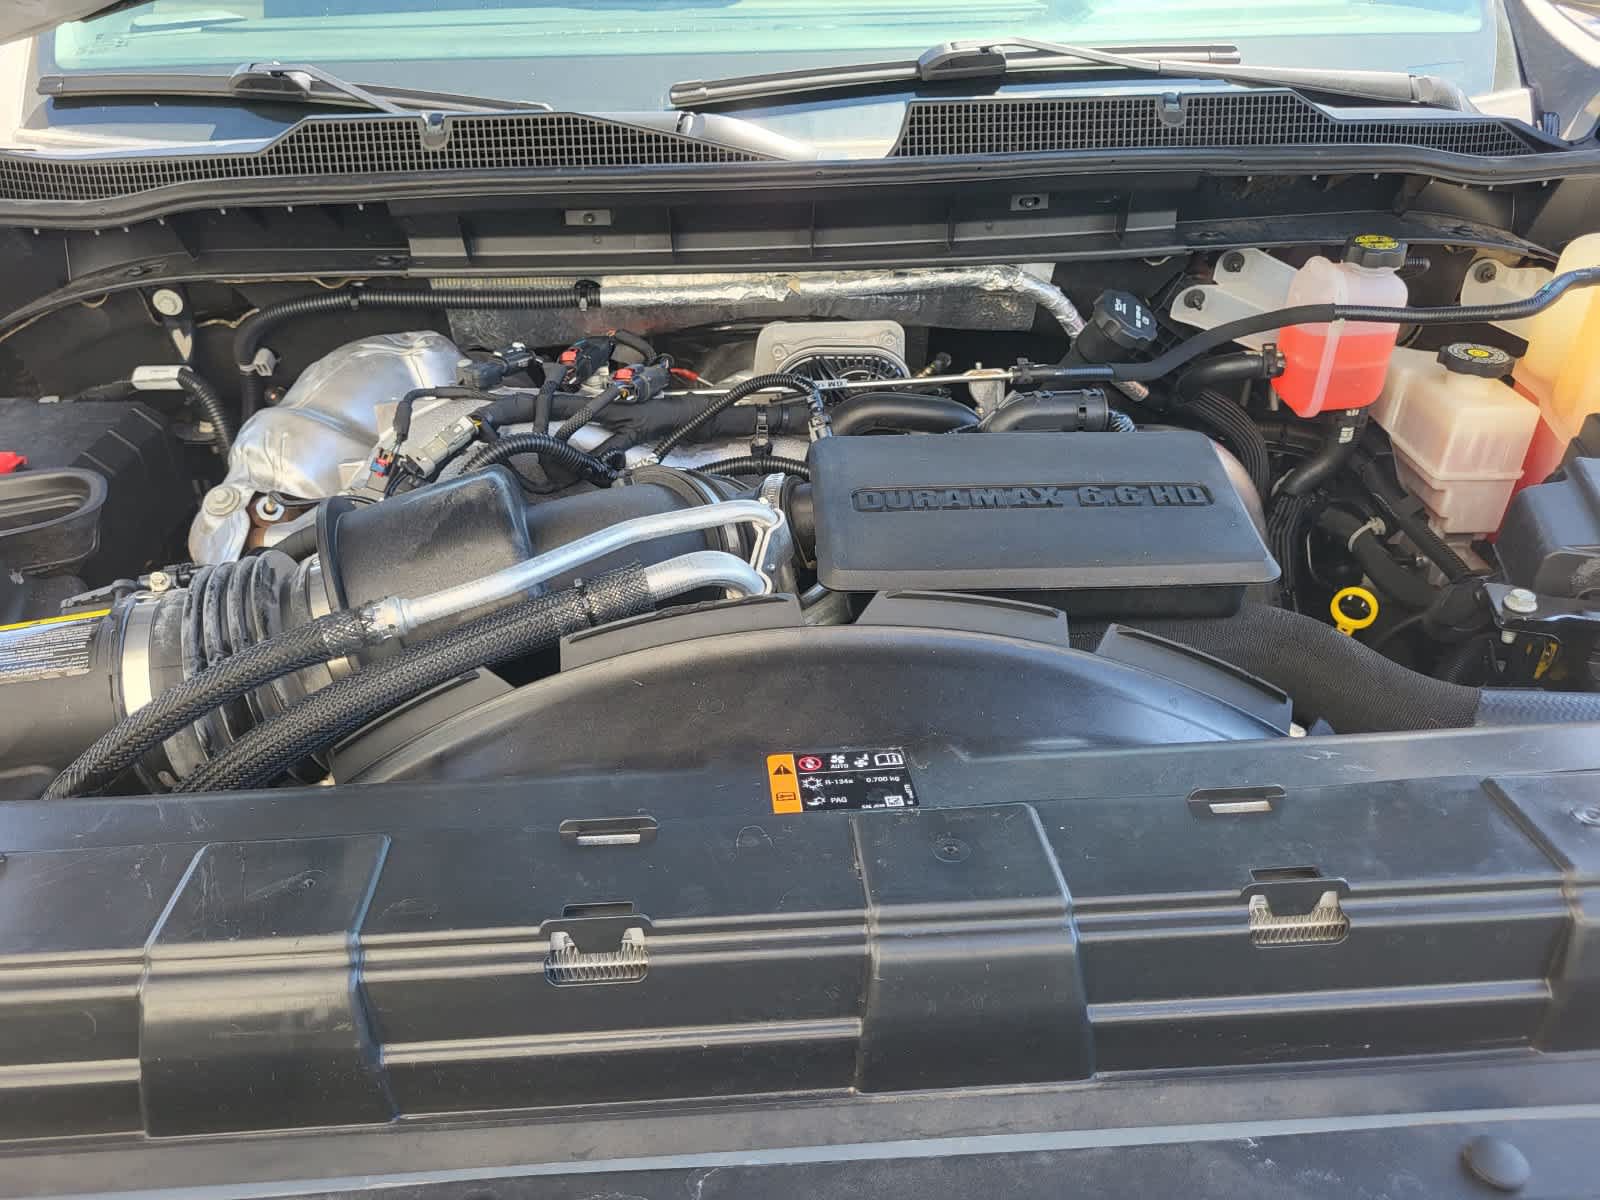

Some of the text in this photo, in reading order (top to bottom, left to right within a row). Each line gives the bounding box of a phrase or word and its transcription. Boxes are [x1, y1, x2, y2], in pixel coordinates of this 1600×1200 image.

[855, 483, 1212, 510] DURAMAX 6.6 HD
